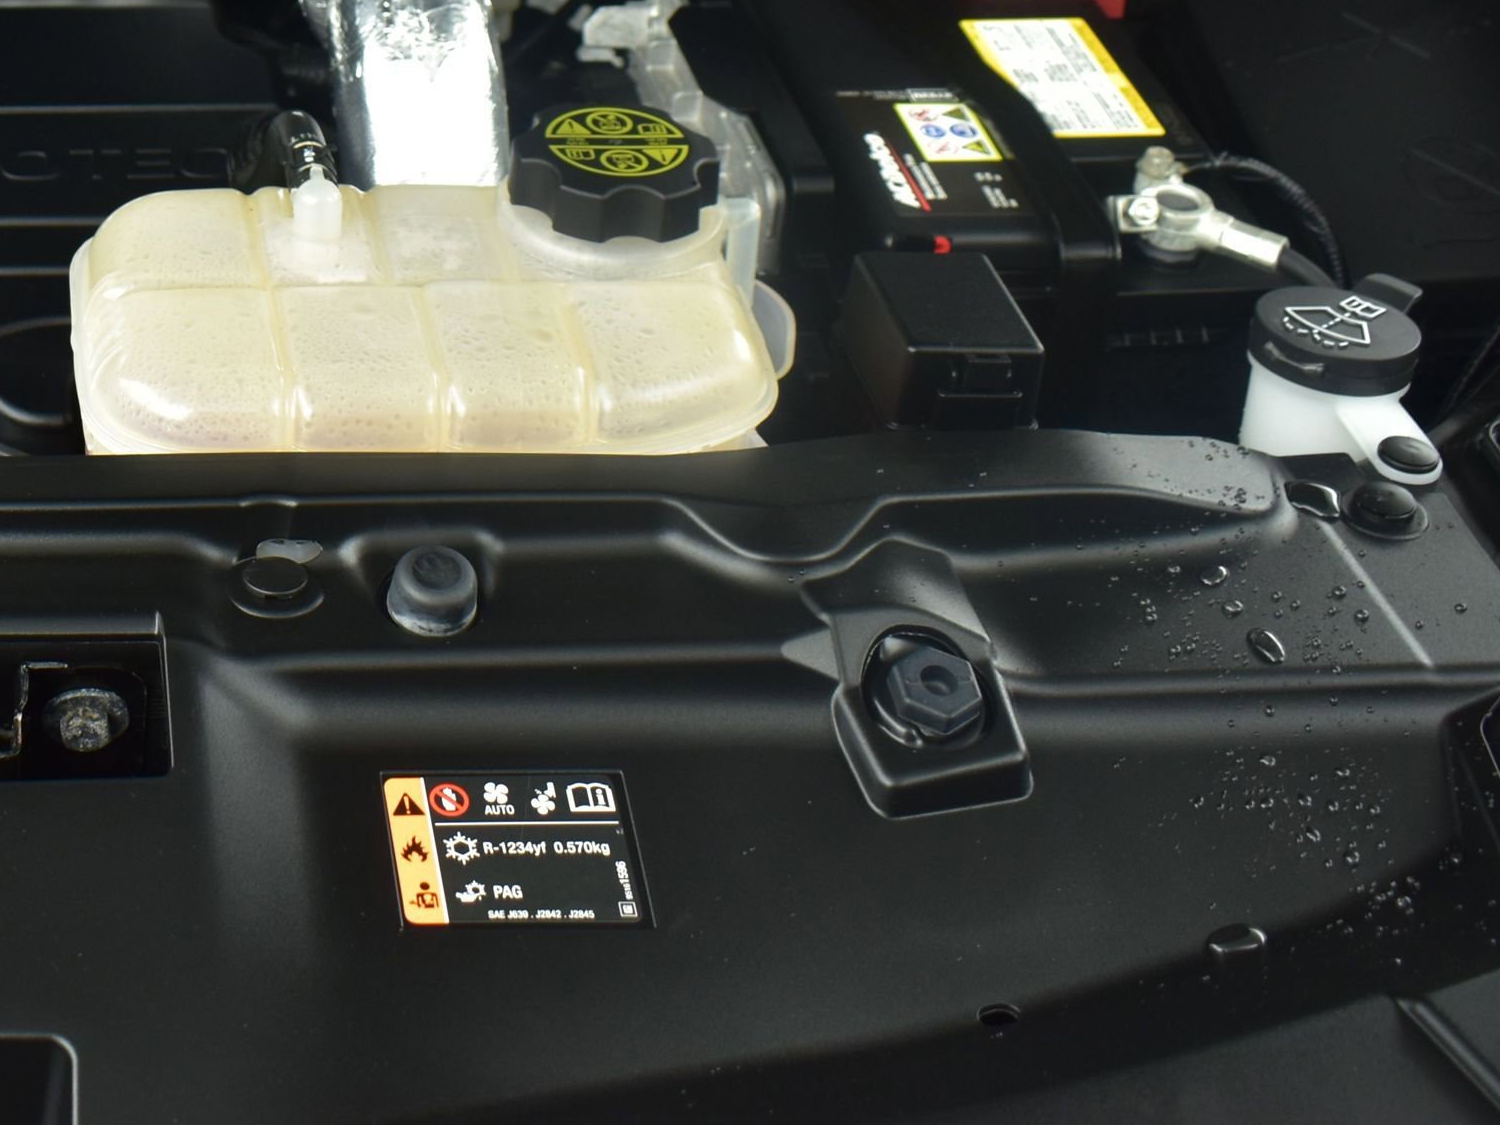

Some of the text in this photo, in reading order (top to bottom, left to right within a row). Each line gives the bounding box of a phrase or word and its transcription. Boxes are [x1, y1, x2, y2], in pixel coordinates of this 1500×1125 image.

[484, 804, 515, 815] AUTO
[482, 841, 611, 857] R-1234yf 0.570kg
[493, 885, 523, 899] PAG
[488, 909, 505, 919] SAE
